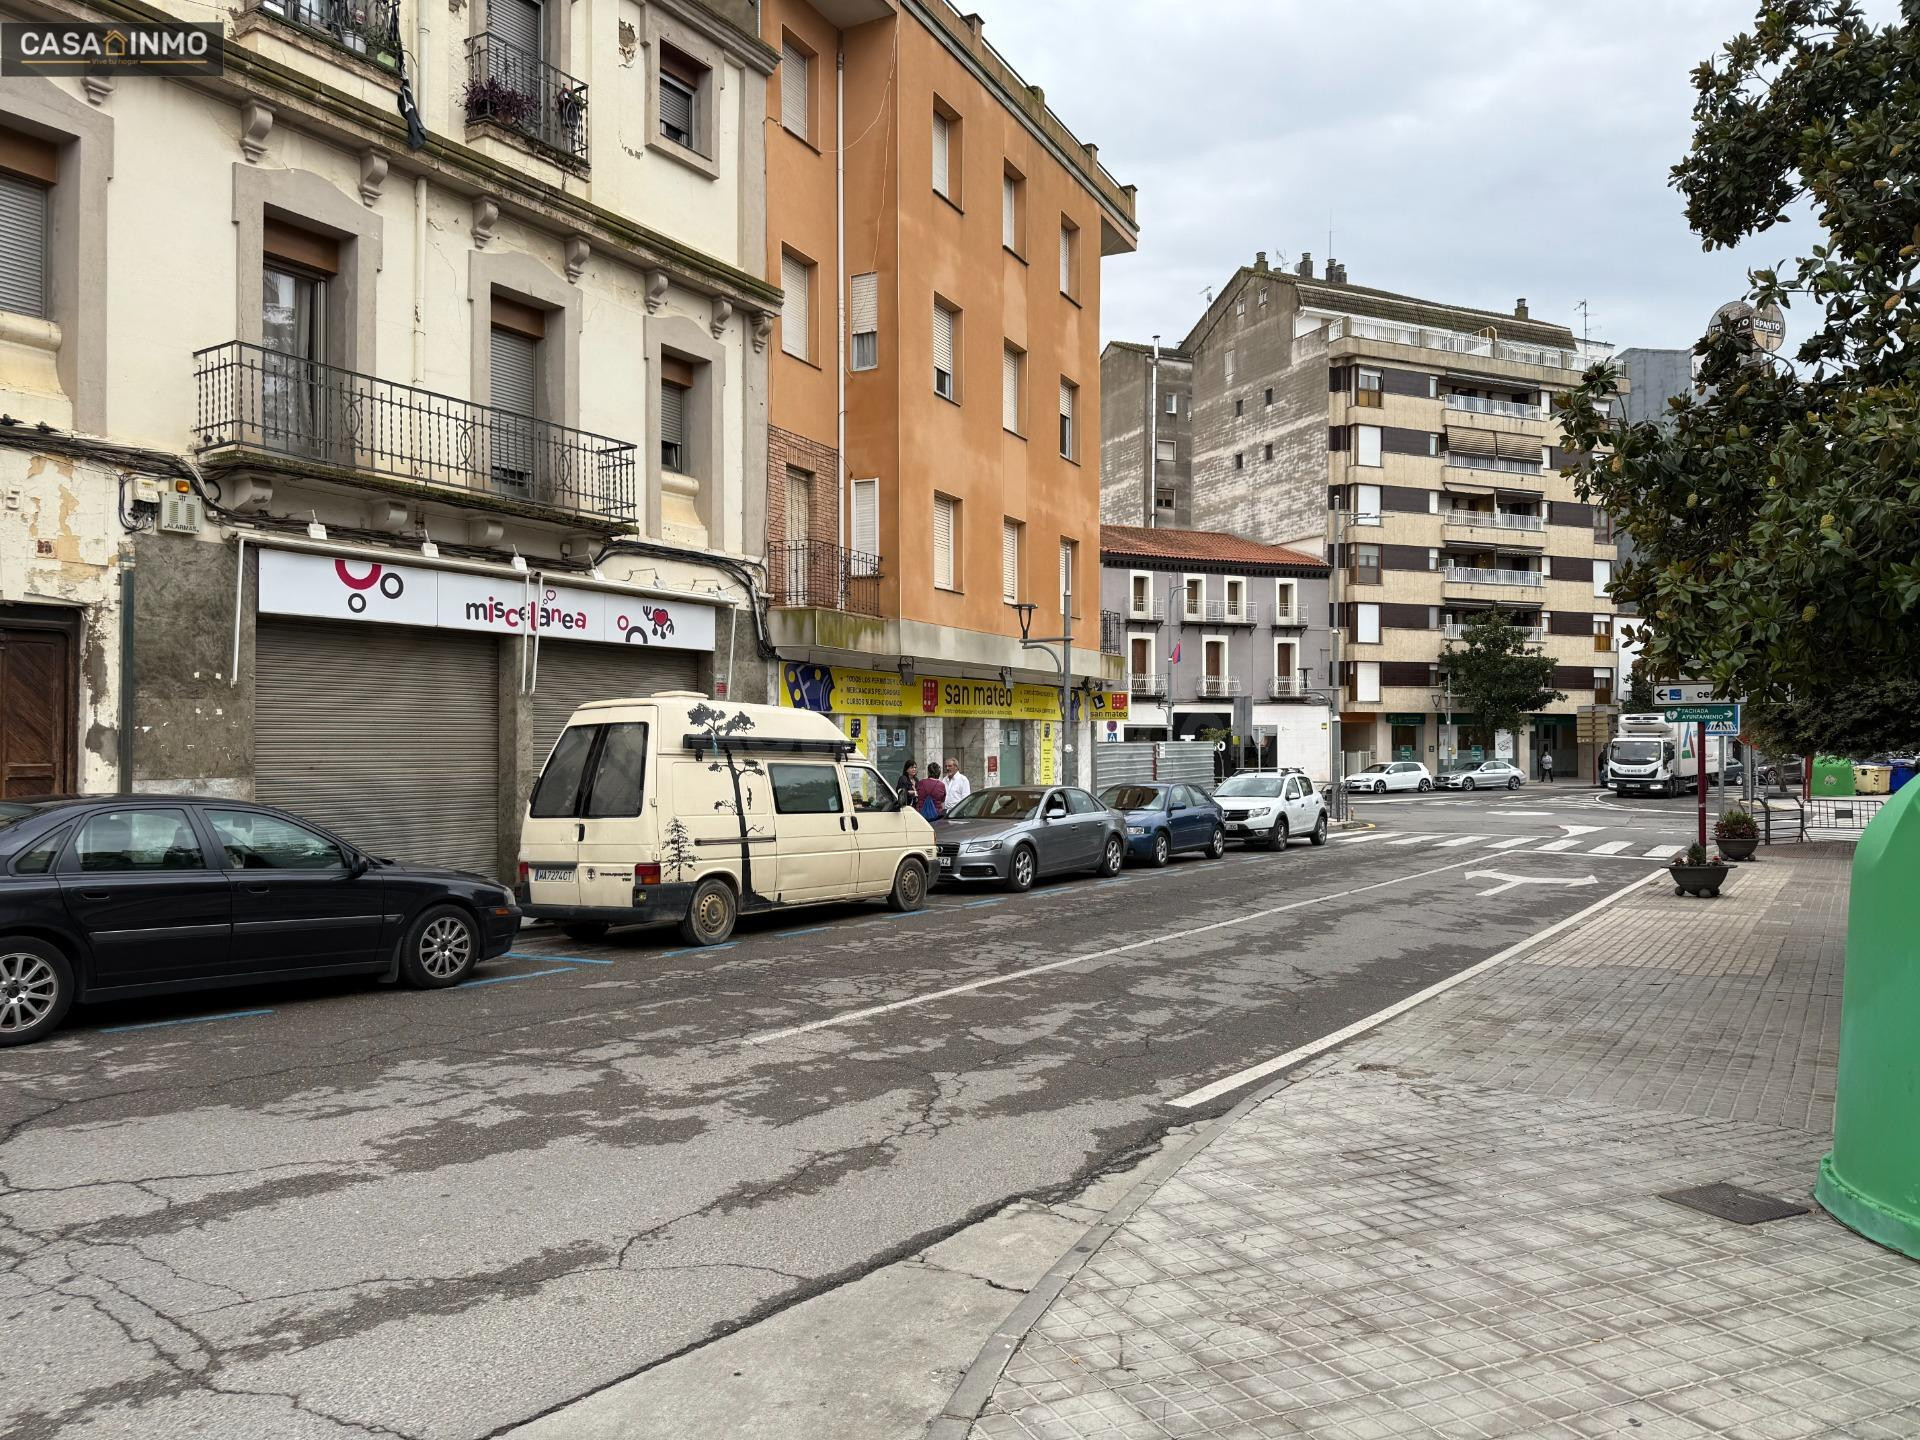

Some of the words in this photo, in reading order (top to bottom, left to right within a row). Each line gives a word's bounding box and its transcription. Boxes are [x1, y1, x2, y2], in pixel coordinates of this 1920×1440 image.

[166, 522, 198, 532] ALARMAS
[945, 684, 969, 705] san
[973, 685, 1013, 707] mateo
